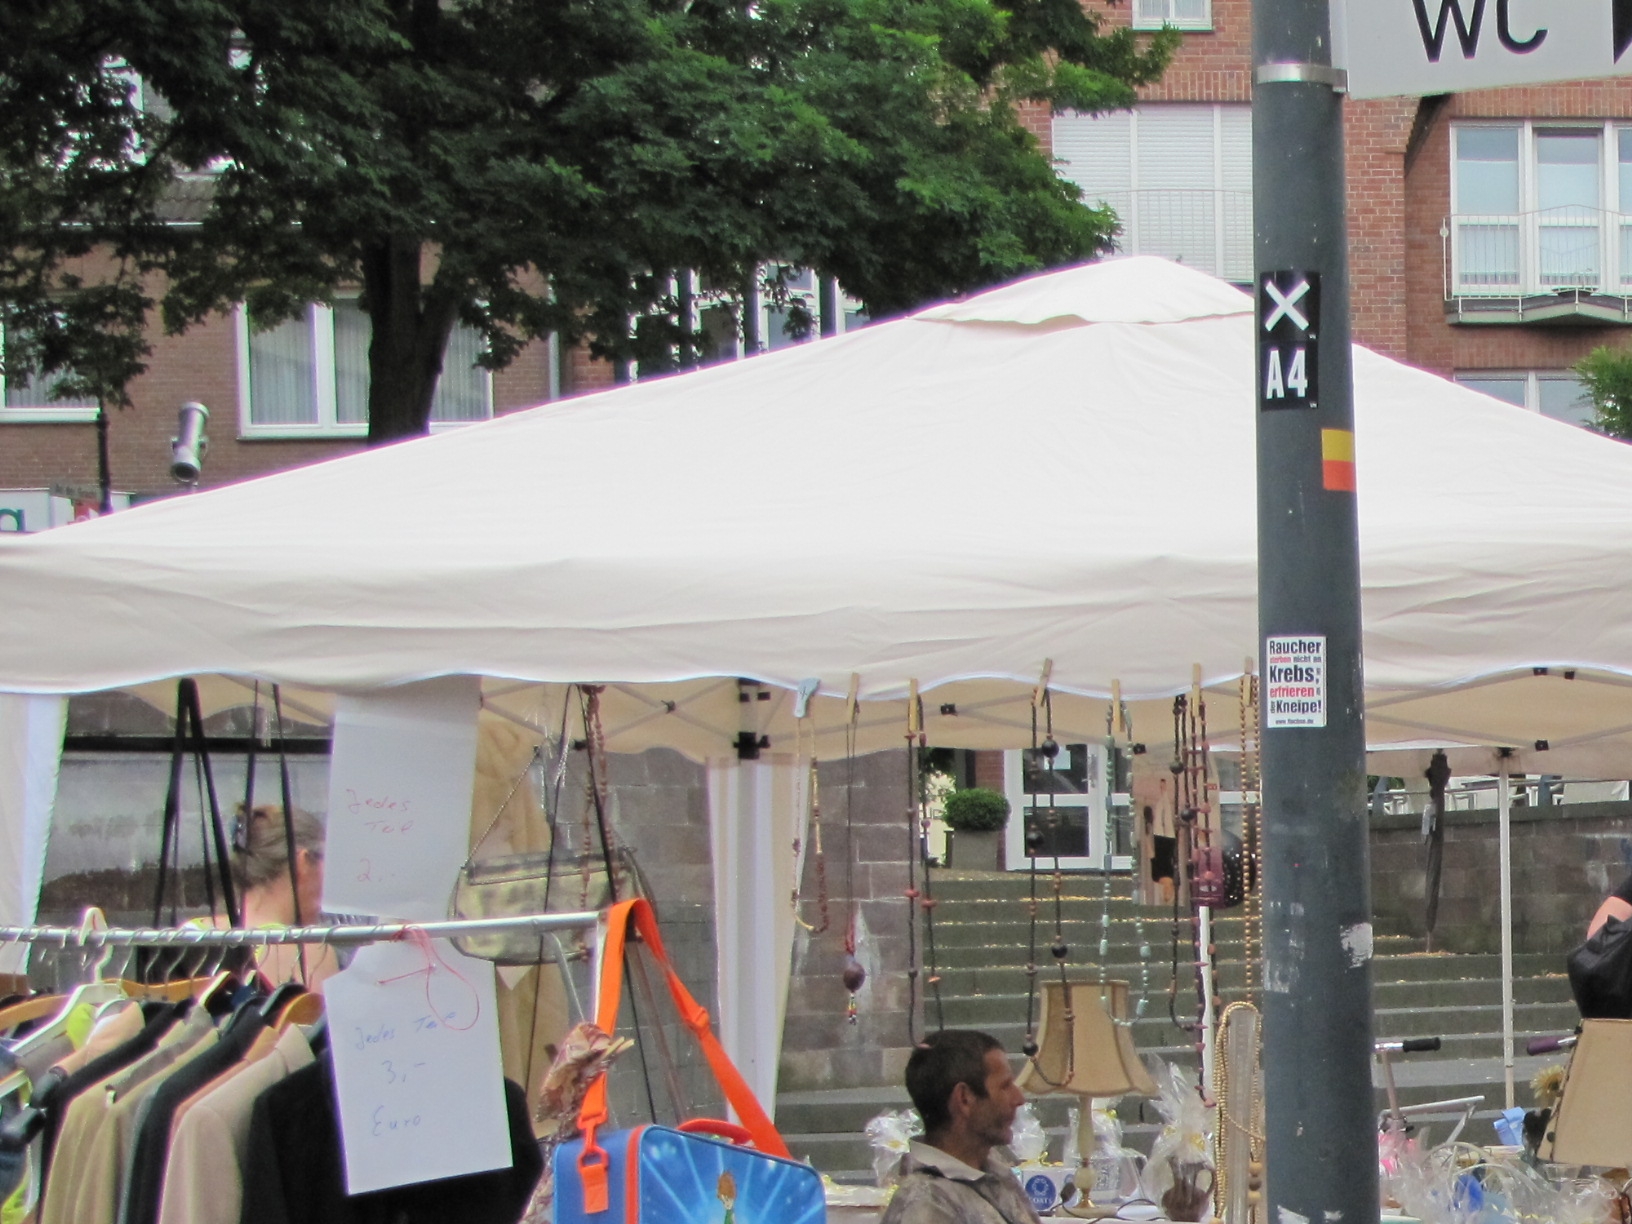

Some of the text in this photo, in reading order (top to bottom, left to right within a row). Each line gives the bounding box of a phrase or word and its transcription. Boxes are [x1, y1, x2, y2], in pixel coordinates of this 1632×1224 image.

[1412, 0, 1549, 63] WC
[1266, 348, 1308, 400] A4
[1269, 639, 1322, 655] Raucher
[1269, 664, 1320, 684] Krebs,
[1269, 686, 1315, 698] erfrieren
[1276, 699, 1322, 714] Kneipe!
